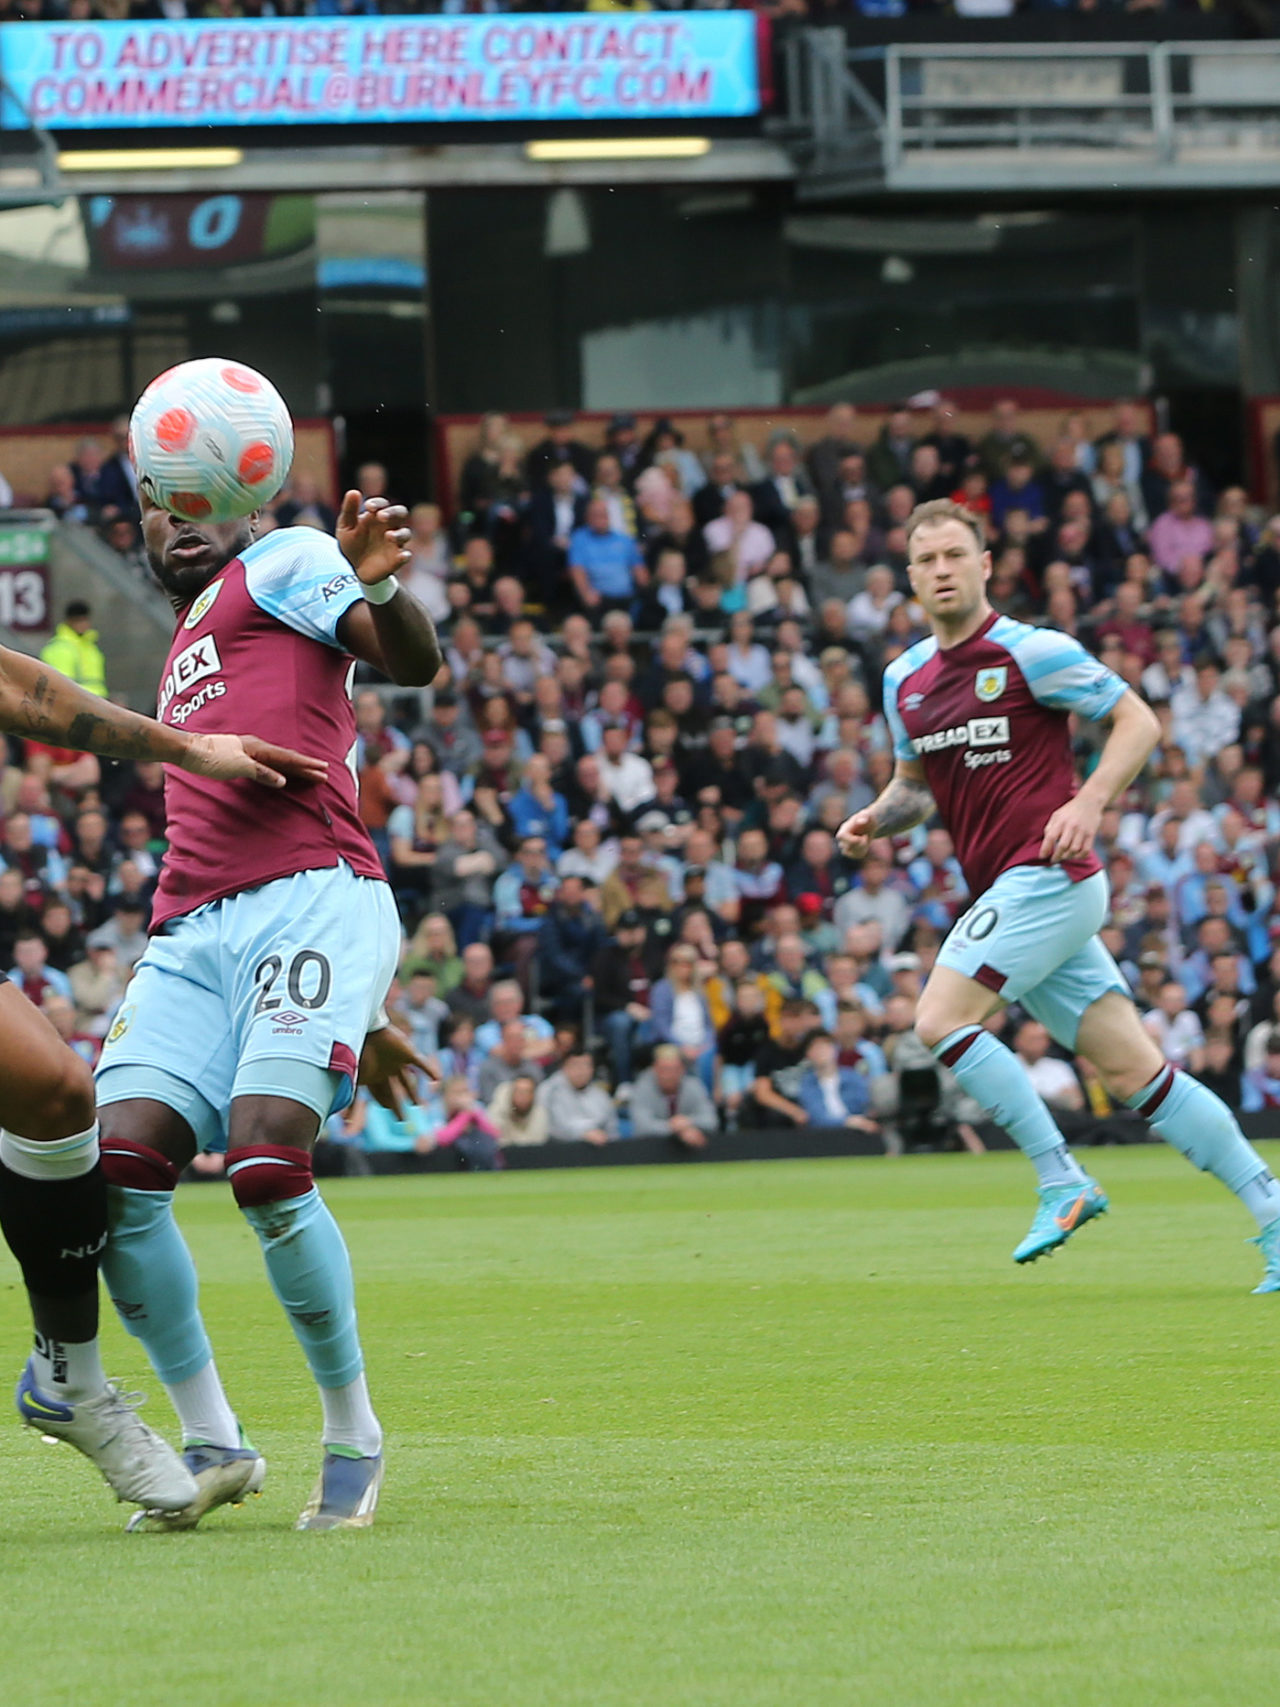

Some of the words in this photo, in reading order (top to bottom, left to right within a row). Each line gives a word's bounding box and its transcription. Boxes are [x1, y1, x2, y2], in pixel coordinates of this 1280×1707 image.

[49, 31, 103, 70] TO
[115, 28, 349, 69] ADVERTISE
[358, 26, 468, 65] HERE
[170, 681, 227, 724] Sports
[964, 750, 1012, 770] Sports
[954, 903, 998, 941] 10
[254, 950, 331, 1016] 20
[272, 1025, 303, 1035] umbro
